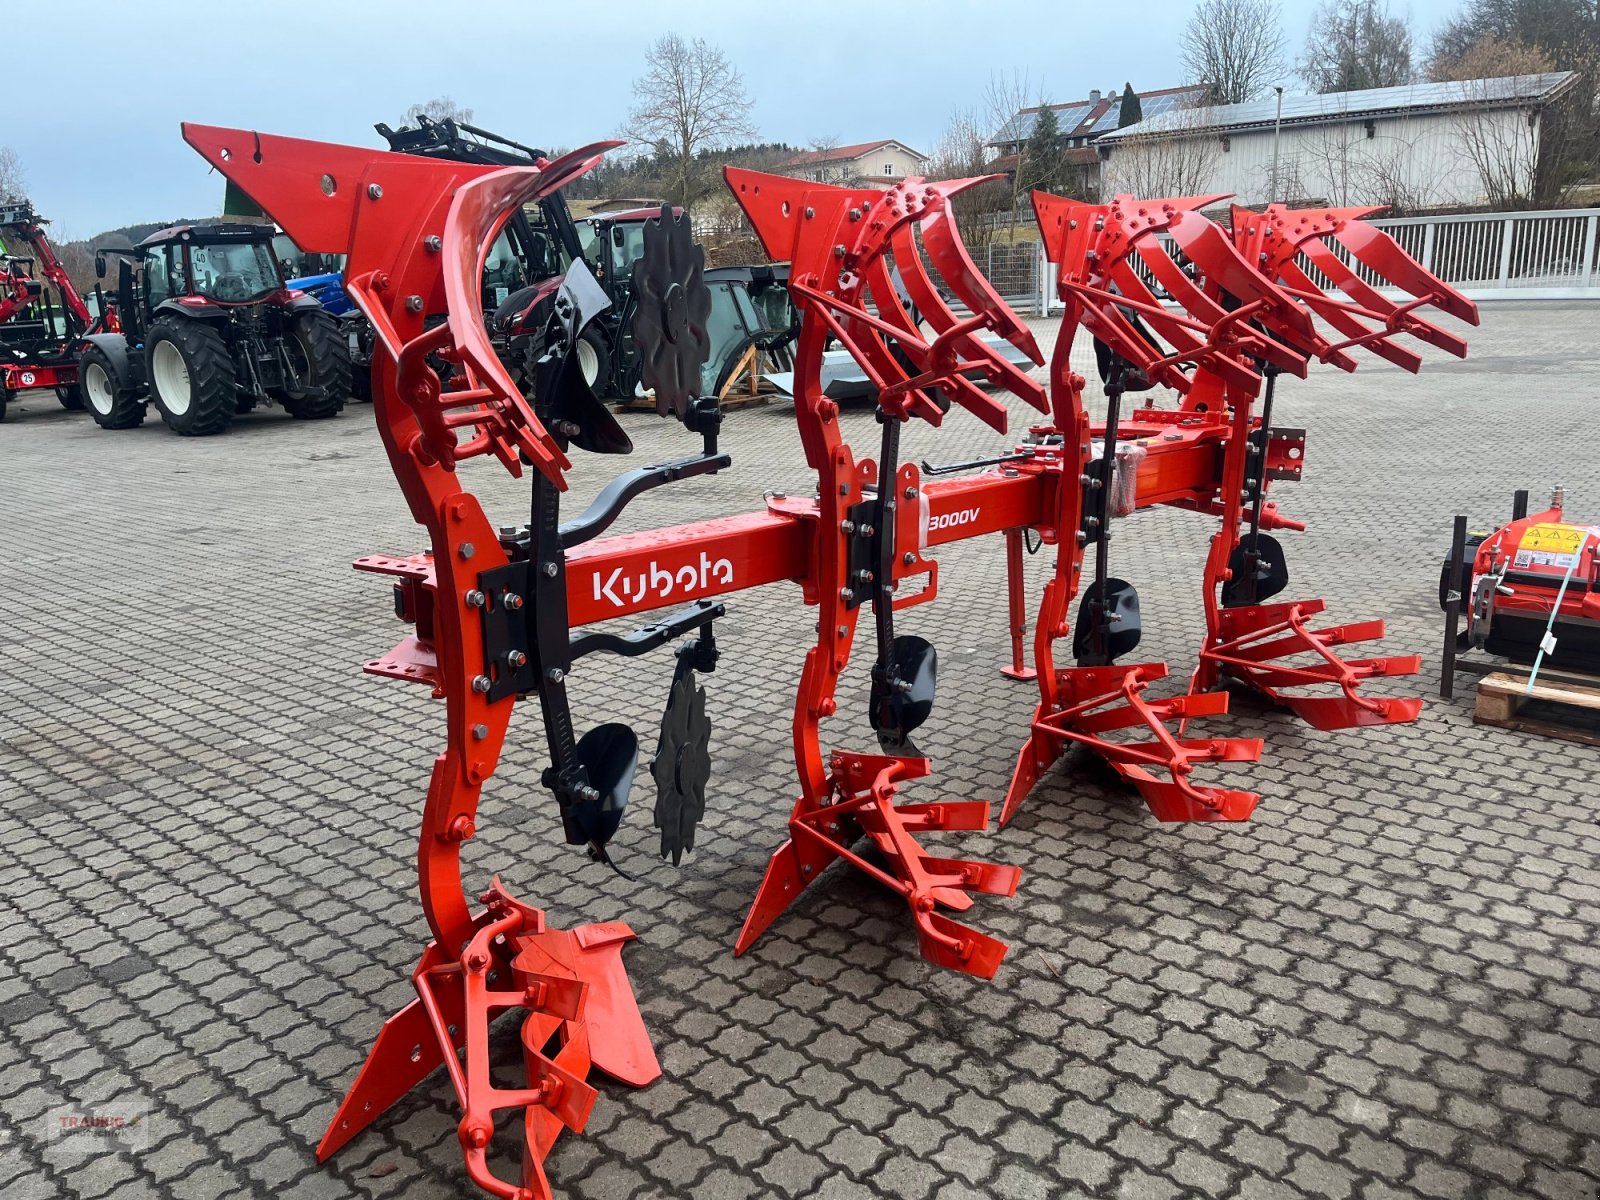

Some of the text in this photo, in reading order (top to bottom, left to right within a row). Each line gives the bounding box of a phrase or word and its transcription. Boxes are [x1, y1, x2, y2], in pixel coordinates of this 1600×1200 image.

[196, 253, 206, 263] 40
[23, 374, 33, 383] 25
[928, 507, 980, 531] 3000V
[593, 551, 733, 607] Kubota
